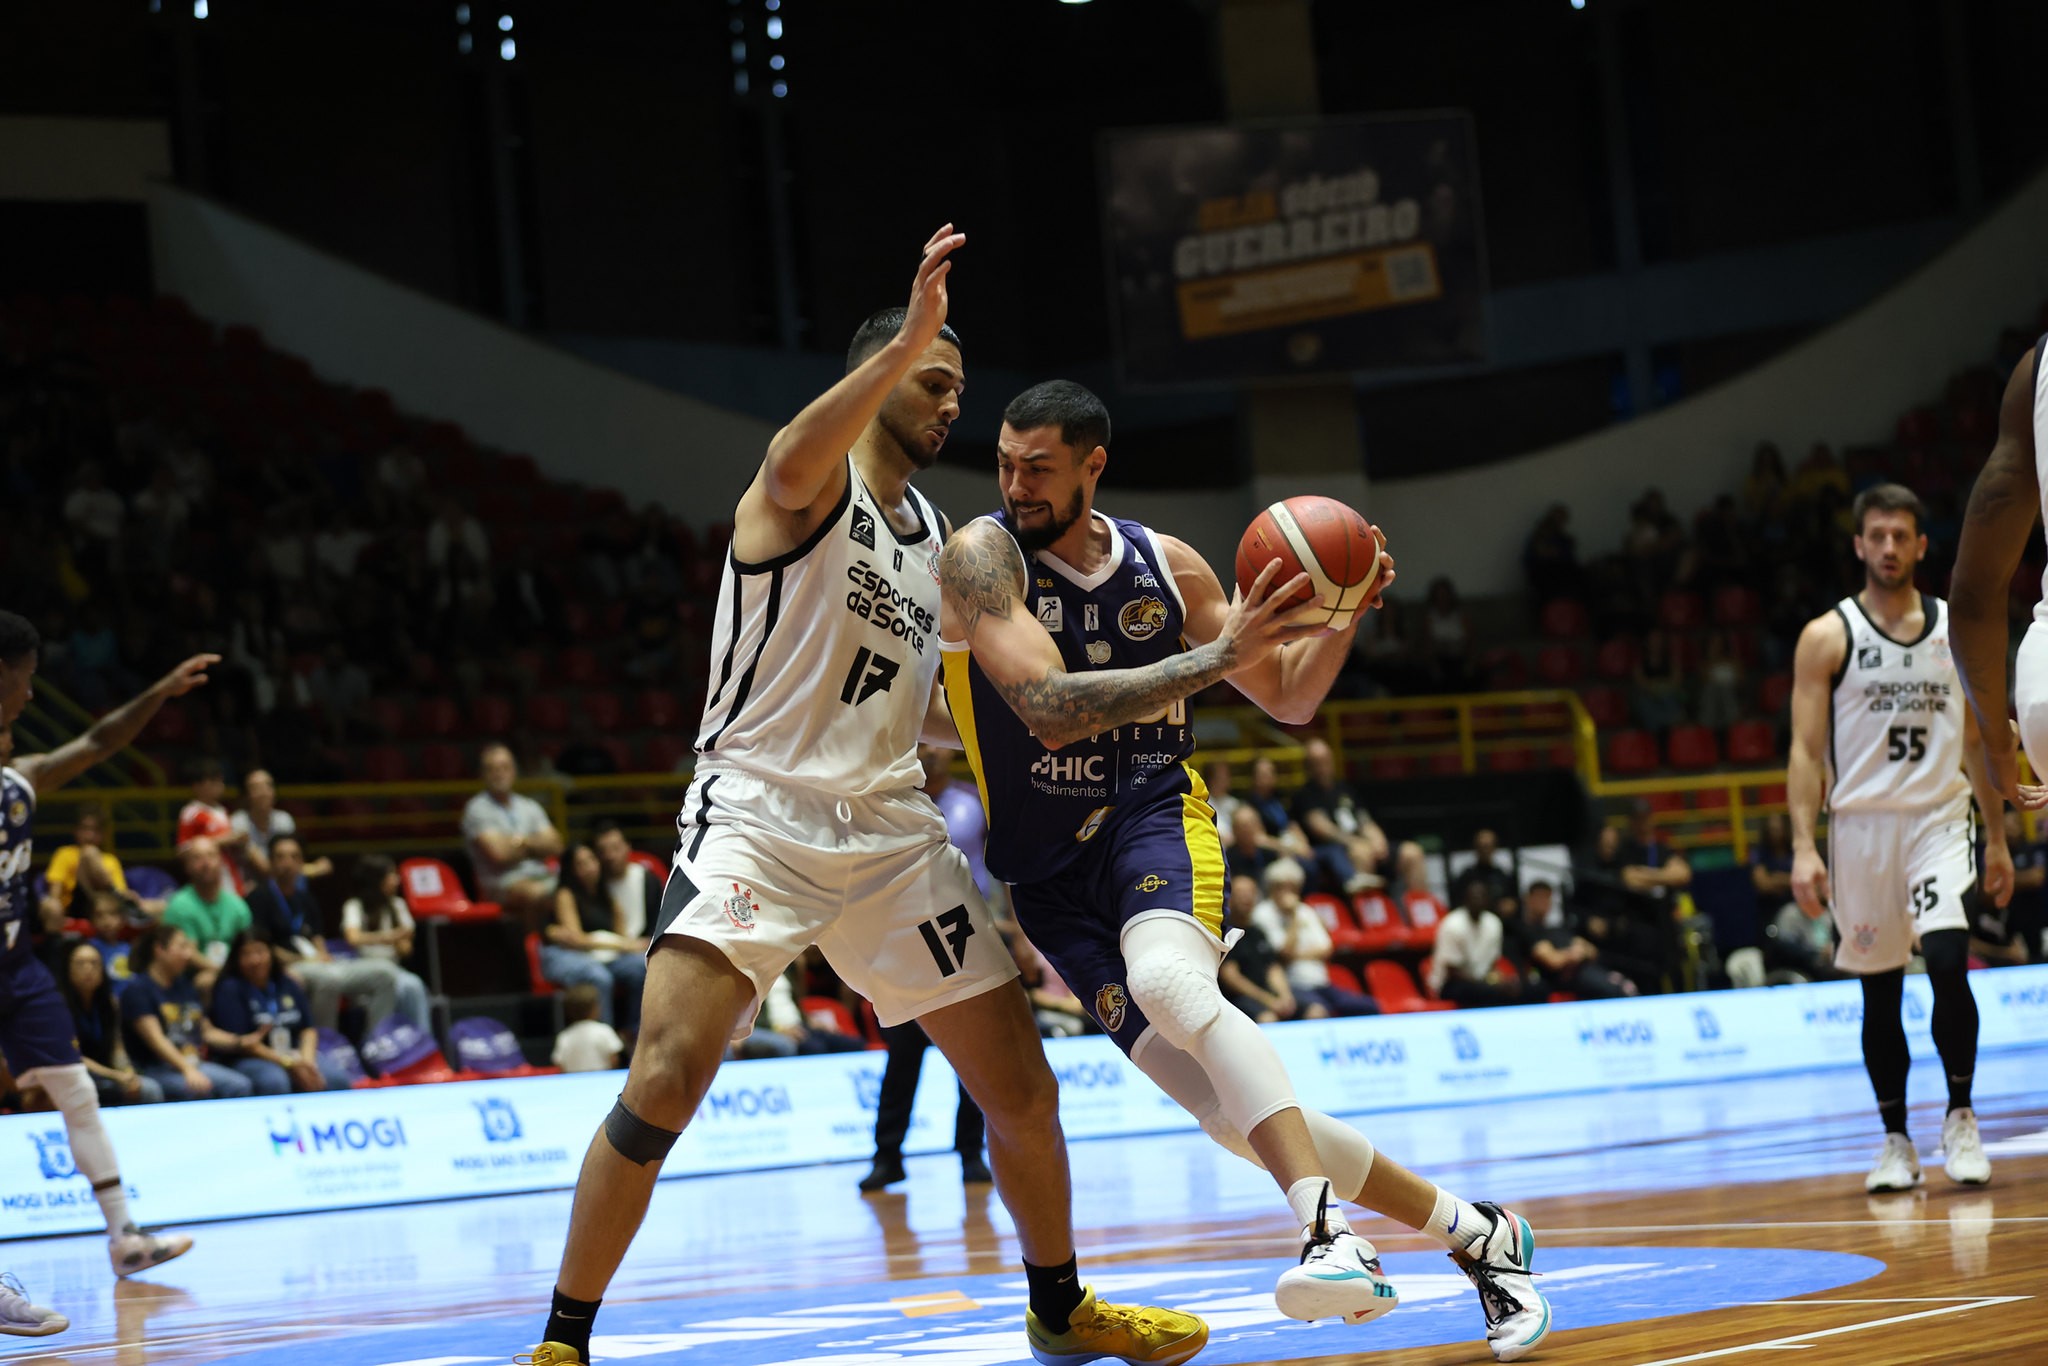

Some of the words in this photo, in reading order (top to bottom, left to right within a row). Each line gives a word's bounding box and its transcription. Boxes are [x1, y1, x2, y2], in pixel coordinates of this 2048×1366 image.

[847, 560, 935, 634] Esportes
[1128, 623, 1152, 632] MOGI
[840, 646, 900, 707] 17
[1888, 726, 1928, 762] 55
[1051, 755, 1105, 782] HIC
[917, 904, 976, 978] 17
[711, 1087, 793, 1118] MOGI
[311, 1117, 408, 1151] MOGI
